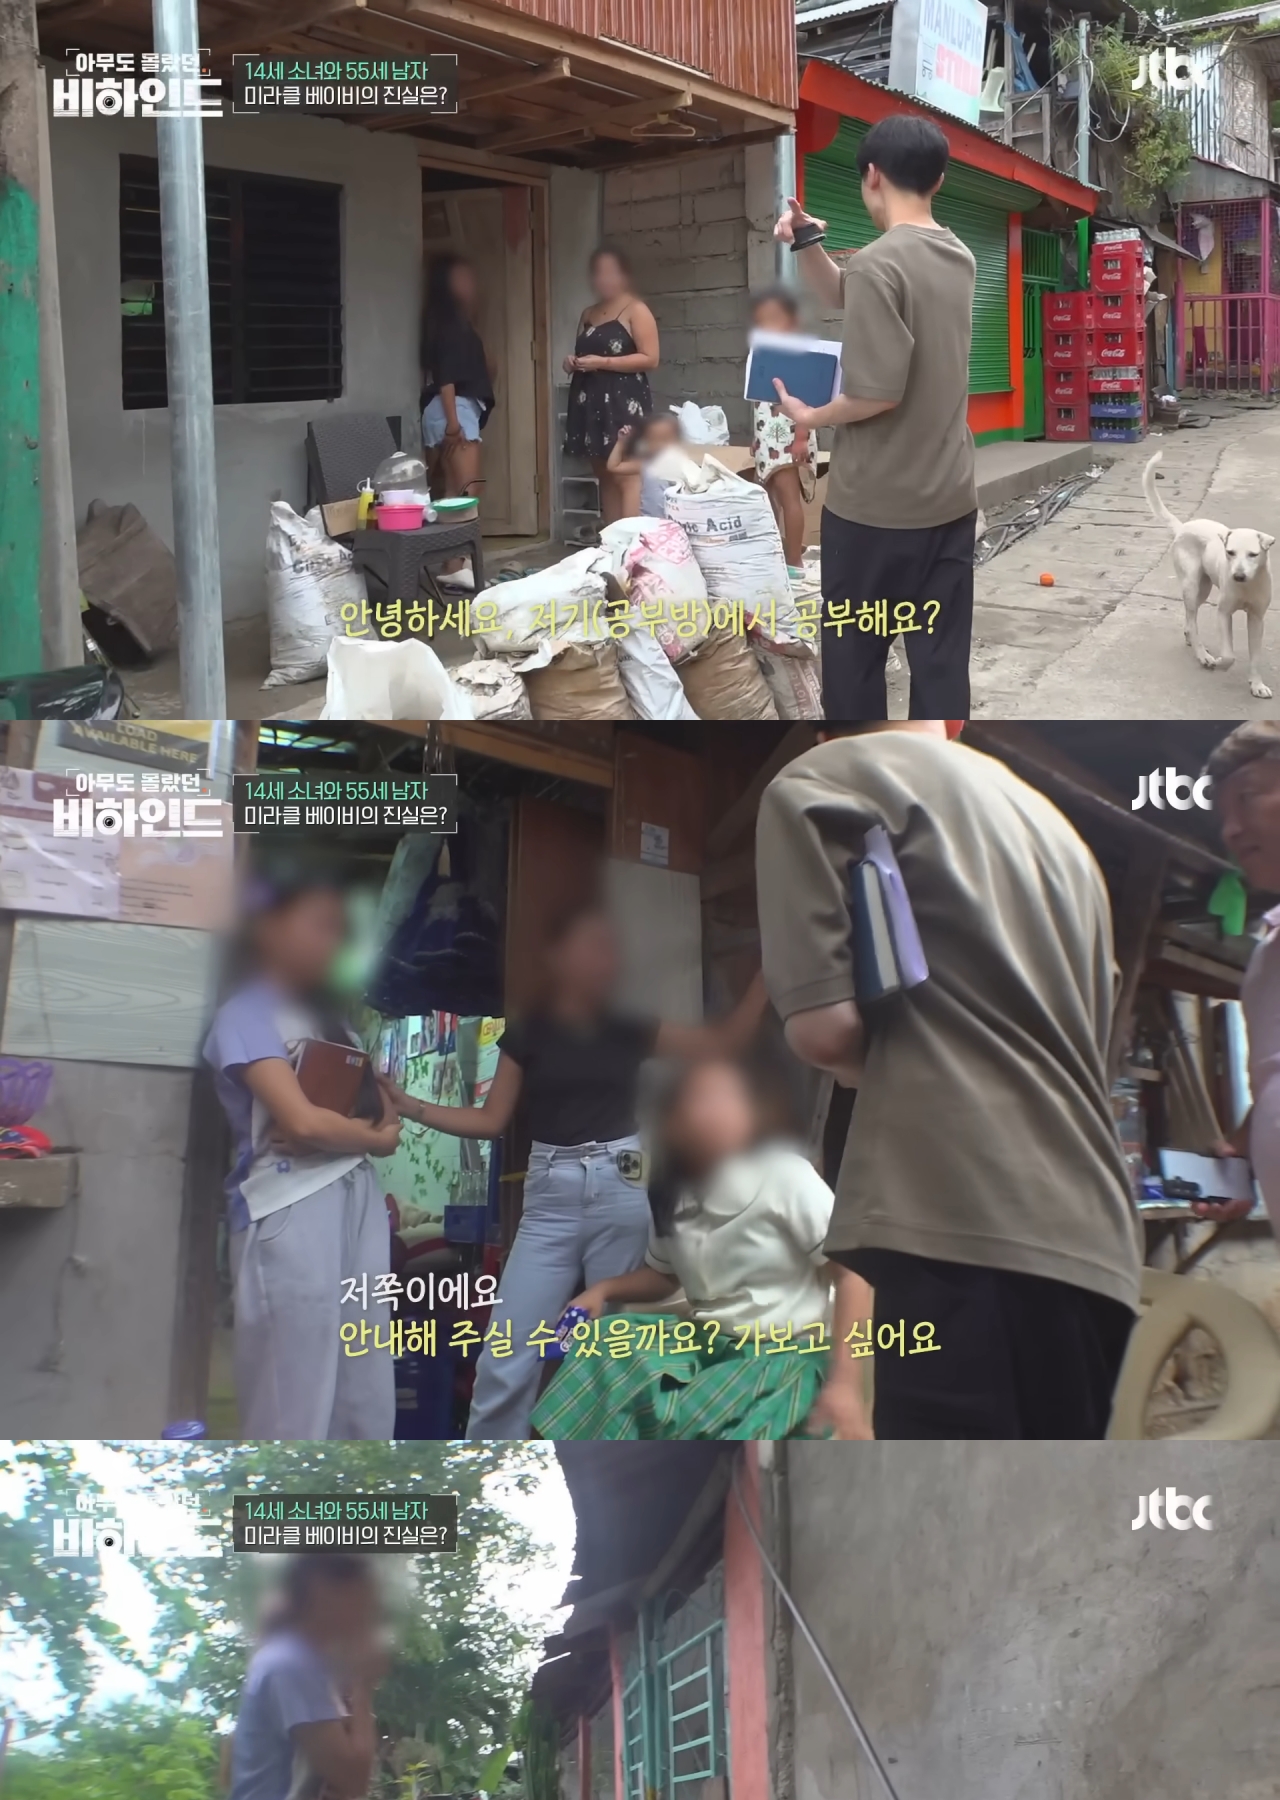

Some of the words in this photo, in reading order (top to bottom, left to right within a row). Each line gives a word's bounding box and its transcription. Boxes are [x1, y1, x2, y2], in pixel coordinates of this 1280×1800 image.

[706, 515, 742, 532] Acid
[116, 722, 158, 742] LOAD
[160, 745, 199, 764] HERE
